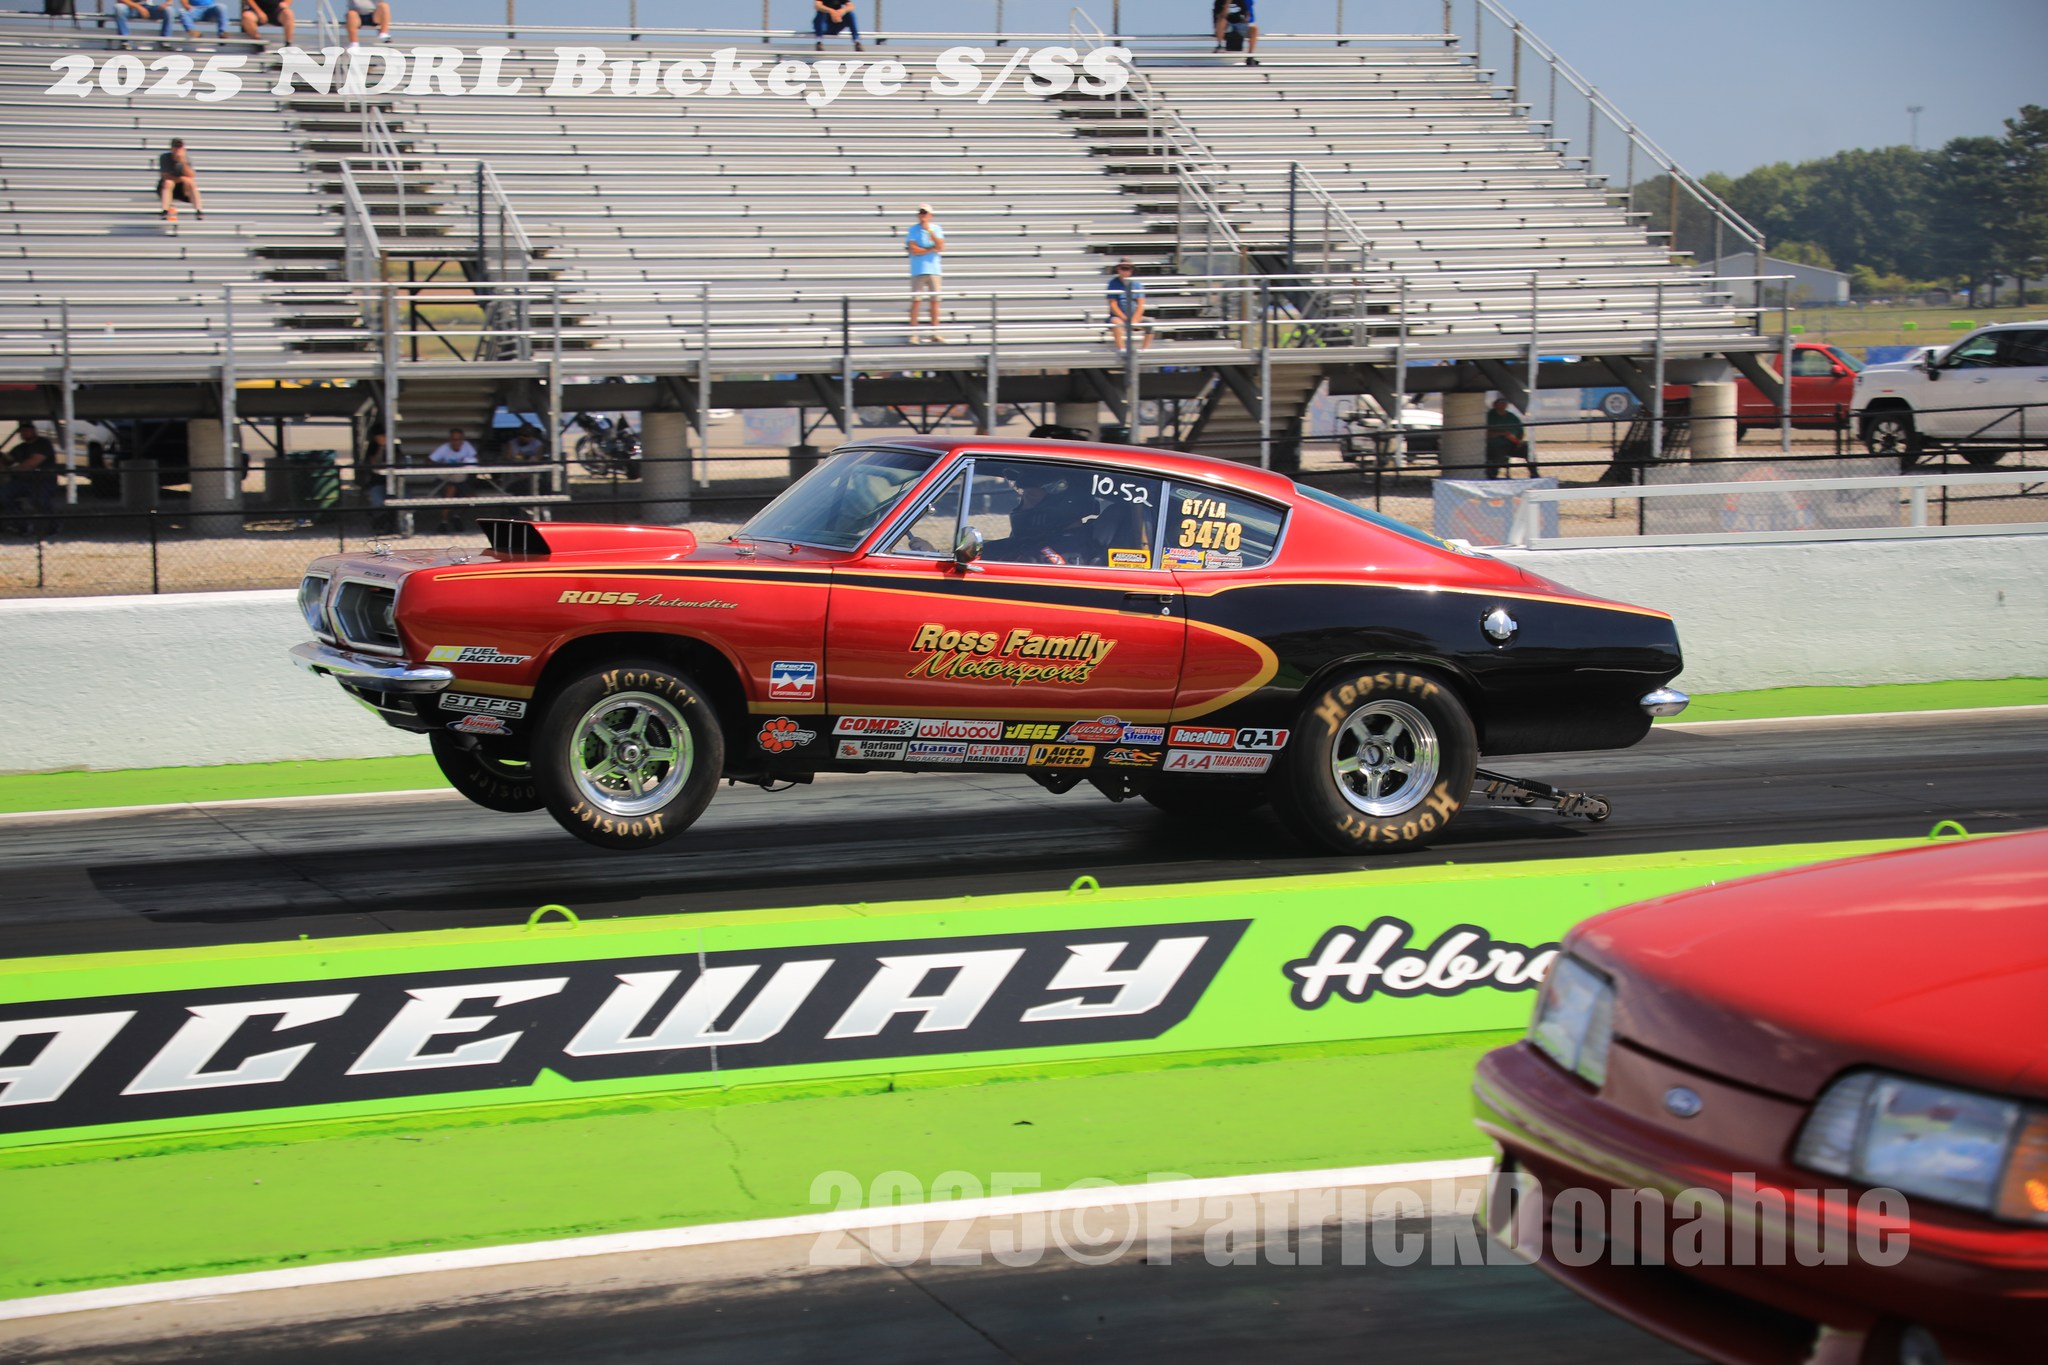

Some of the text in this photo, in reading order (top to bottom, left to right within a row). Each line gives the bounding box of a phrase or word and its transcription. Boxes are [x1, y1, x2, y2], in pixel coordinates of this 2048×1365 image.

[1091, 474, 1153, 507] 10.52
[1181, 498, 1226, 519] GT/LA
[1178, 518, 1242, 551] 3478
[558, 590, 739, 609] ROSS Automotive
[911, 624, 1116, 664] Ross Family
[457, 655, 525, 663] FACTORY
[908, 650, 1092, 686] Motorsports
[602, 669, 697, 707] Hoosier
[444, 695, 522, 712] STEF'S
[1314, 672, 1440, 737] Hoosier
[839, 718, 900, 731] COMP
[919, 721, 1002, 739] wilwood
[1004, 724, 1060, 739] JEGS
[1072, 726, 1103, 734] LUCAS
[1123, 732, 1163, 741] Strange
[1174, 729, 1230, 745] RaceQuip
[1236, 729, 1288, 748] QA1
[860, 741, 903, 750] Harland
[909, 742, 965, 753] Strange
[969, 745, 1028, 757] G-FORCE
[1050, 747, 1085, 756] Auto
[863, 750, 896, 759] Sharp
[1044, 756, 1089, 765] Meter
[1212, 755, 1267, 767] TRANSMISSION
[1335, 780, 1460, 842] Hoosier
[571, 801, 664, 839] Hoosier
